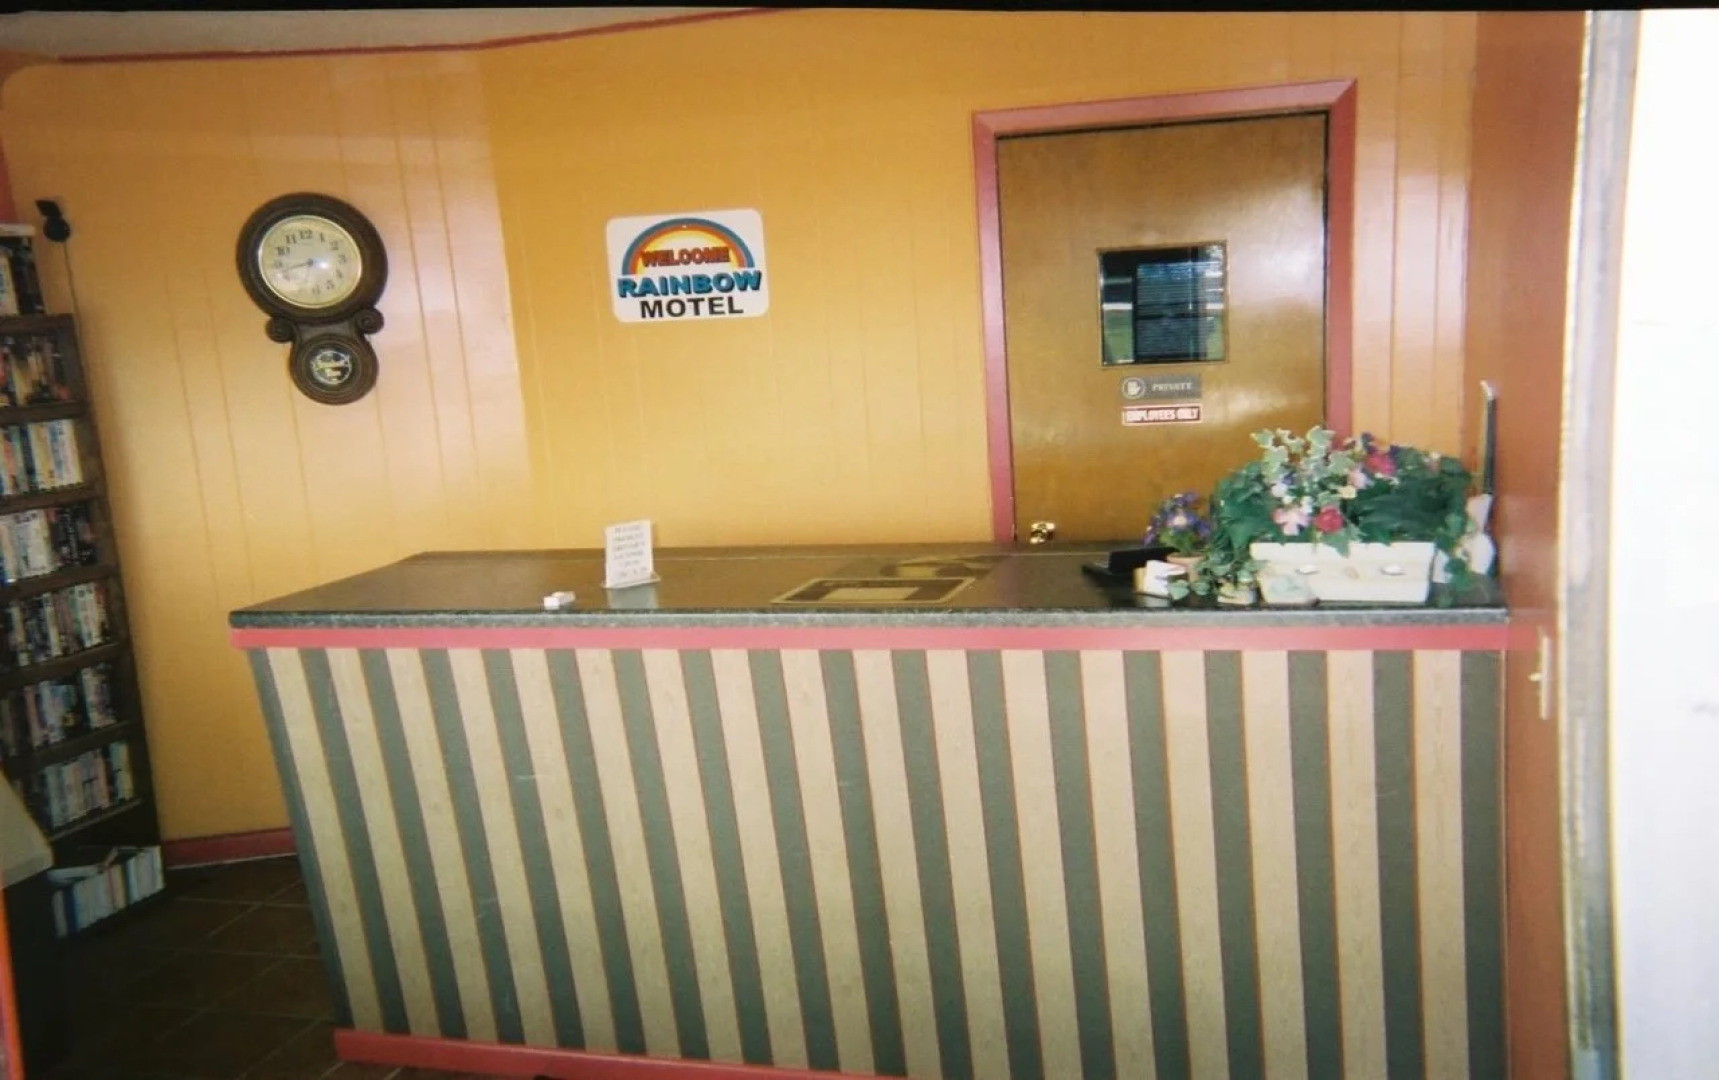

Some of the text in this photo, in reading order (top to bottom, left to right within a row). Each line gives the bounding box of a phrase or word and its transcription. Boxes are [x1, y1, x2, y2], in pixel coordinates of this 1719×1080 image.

[286, 234, 297, 244] 11
[299, 229, 313, 240] 12
[275, 246, 291, 256] 10
[640, 246, 731, 267] WELCOME
[617, 270, 763, 298] RAINBOW
[639, 296, 744, 319] MOTEL
[1152, 382, 1193, 392] PRIVATE
[1127, 407, 1199, 423] EMPLOYEES ONLY
